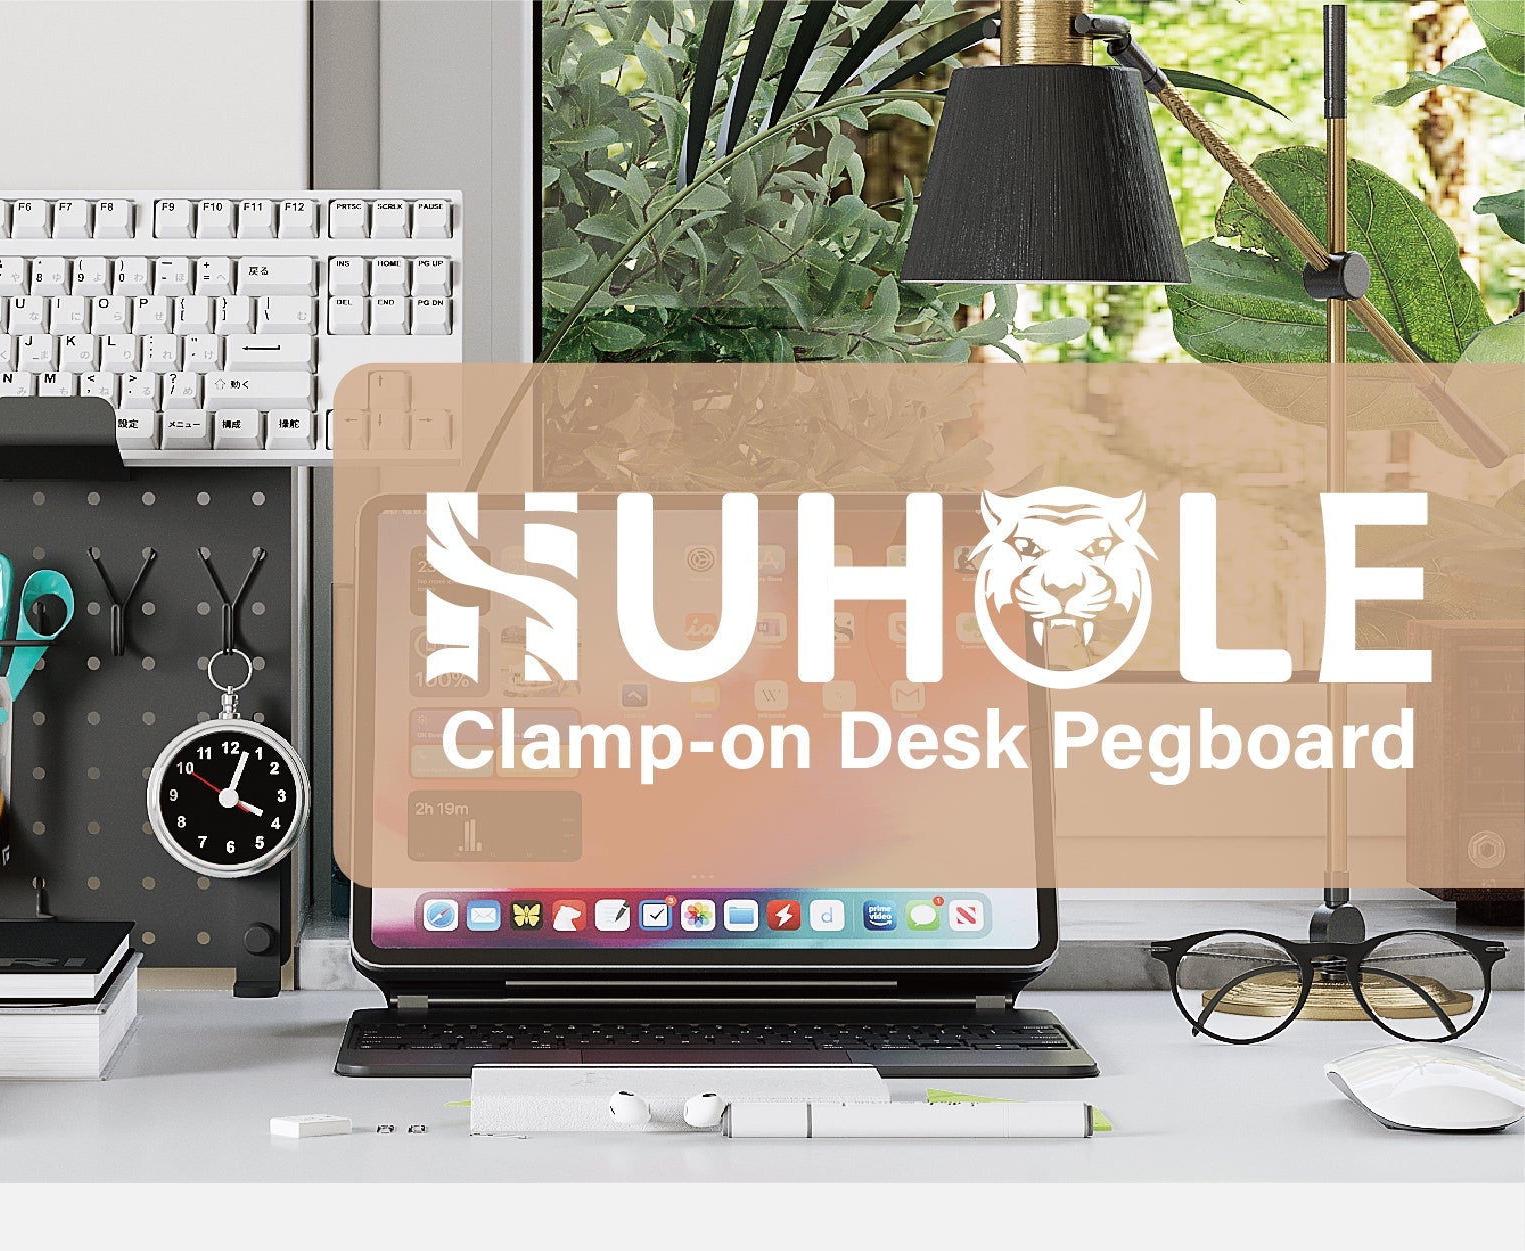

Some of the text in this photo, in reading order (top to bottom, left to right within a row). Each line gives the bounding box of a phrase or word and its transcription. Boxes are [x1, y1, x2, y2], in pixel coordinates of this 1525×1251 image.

[19, 203, 31, 211] F6
[59, 203, 72, 211] F7
[101, 203, 113, 211] F8
[162, 203, 174, 211] F9
[204, 203, 222, 211] F10
[244, 203, 262, 211] F11
[285, 203, 304, 211] F12
[249, 267, 268, 275] 戻る
[16, 299, 25, 308] U
[99, 299, 109, 308] O
[140, 299, 148, 308] P
[25, 336, 32, 345] J
[67, 336, 75, 345] K
[108, 336, 116, 345] L
[3, 374, 12, 383] N
[44, 374, 56, 383] M
[231, 381, 248, 389] 動く
[197, 747, 211, 759] 11
[222, 742, 239, 754] 12
[255, 748, 262, 760] 1
[176, 762, 193, 775] 10
[270, 762, 279, 775] 2
[170, 789, 178, 801] 9
[278, 789, 286, 802] 3
[415, 803, 469, 816] 2h 19m
[178, 816, 186, 828] 8
[271, 817, 280, 829] 4
[198, 836, 207, 848] 7
[227, 841, 234, 853] 6
[255, 836, 264, 849] 5
